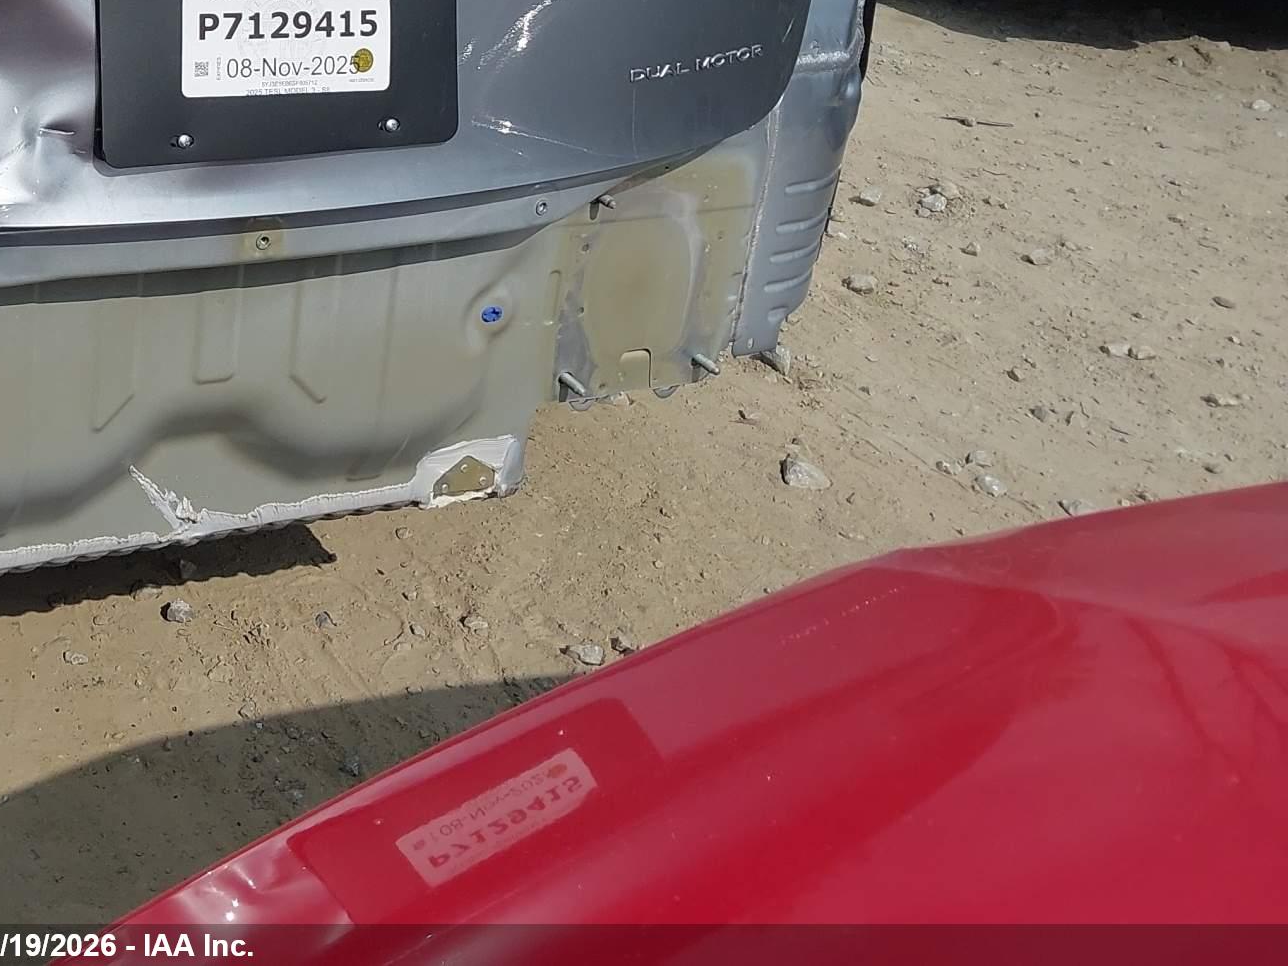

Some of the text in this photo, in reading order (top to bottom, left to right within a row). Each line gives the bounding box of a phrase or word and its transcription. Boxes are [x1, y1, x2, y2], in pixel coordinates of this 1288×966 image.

[198, 10, 378, 40] P7129415
[226, 55, 360, 78] 08-Nov-2025
[630, 44, 763, 82] DUAL MOTOR
